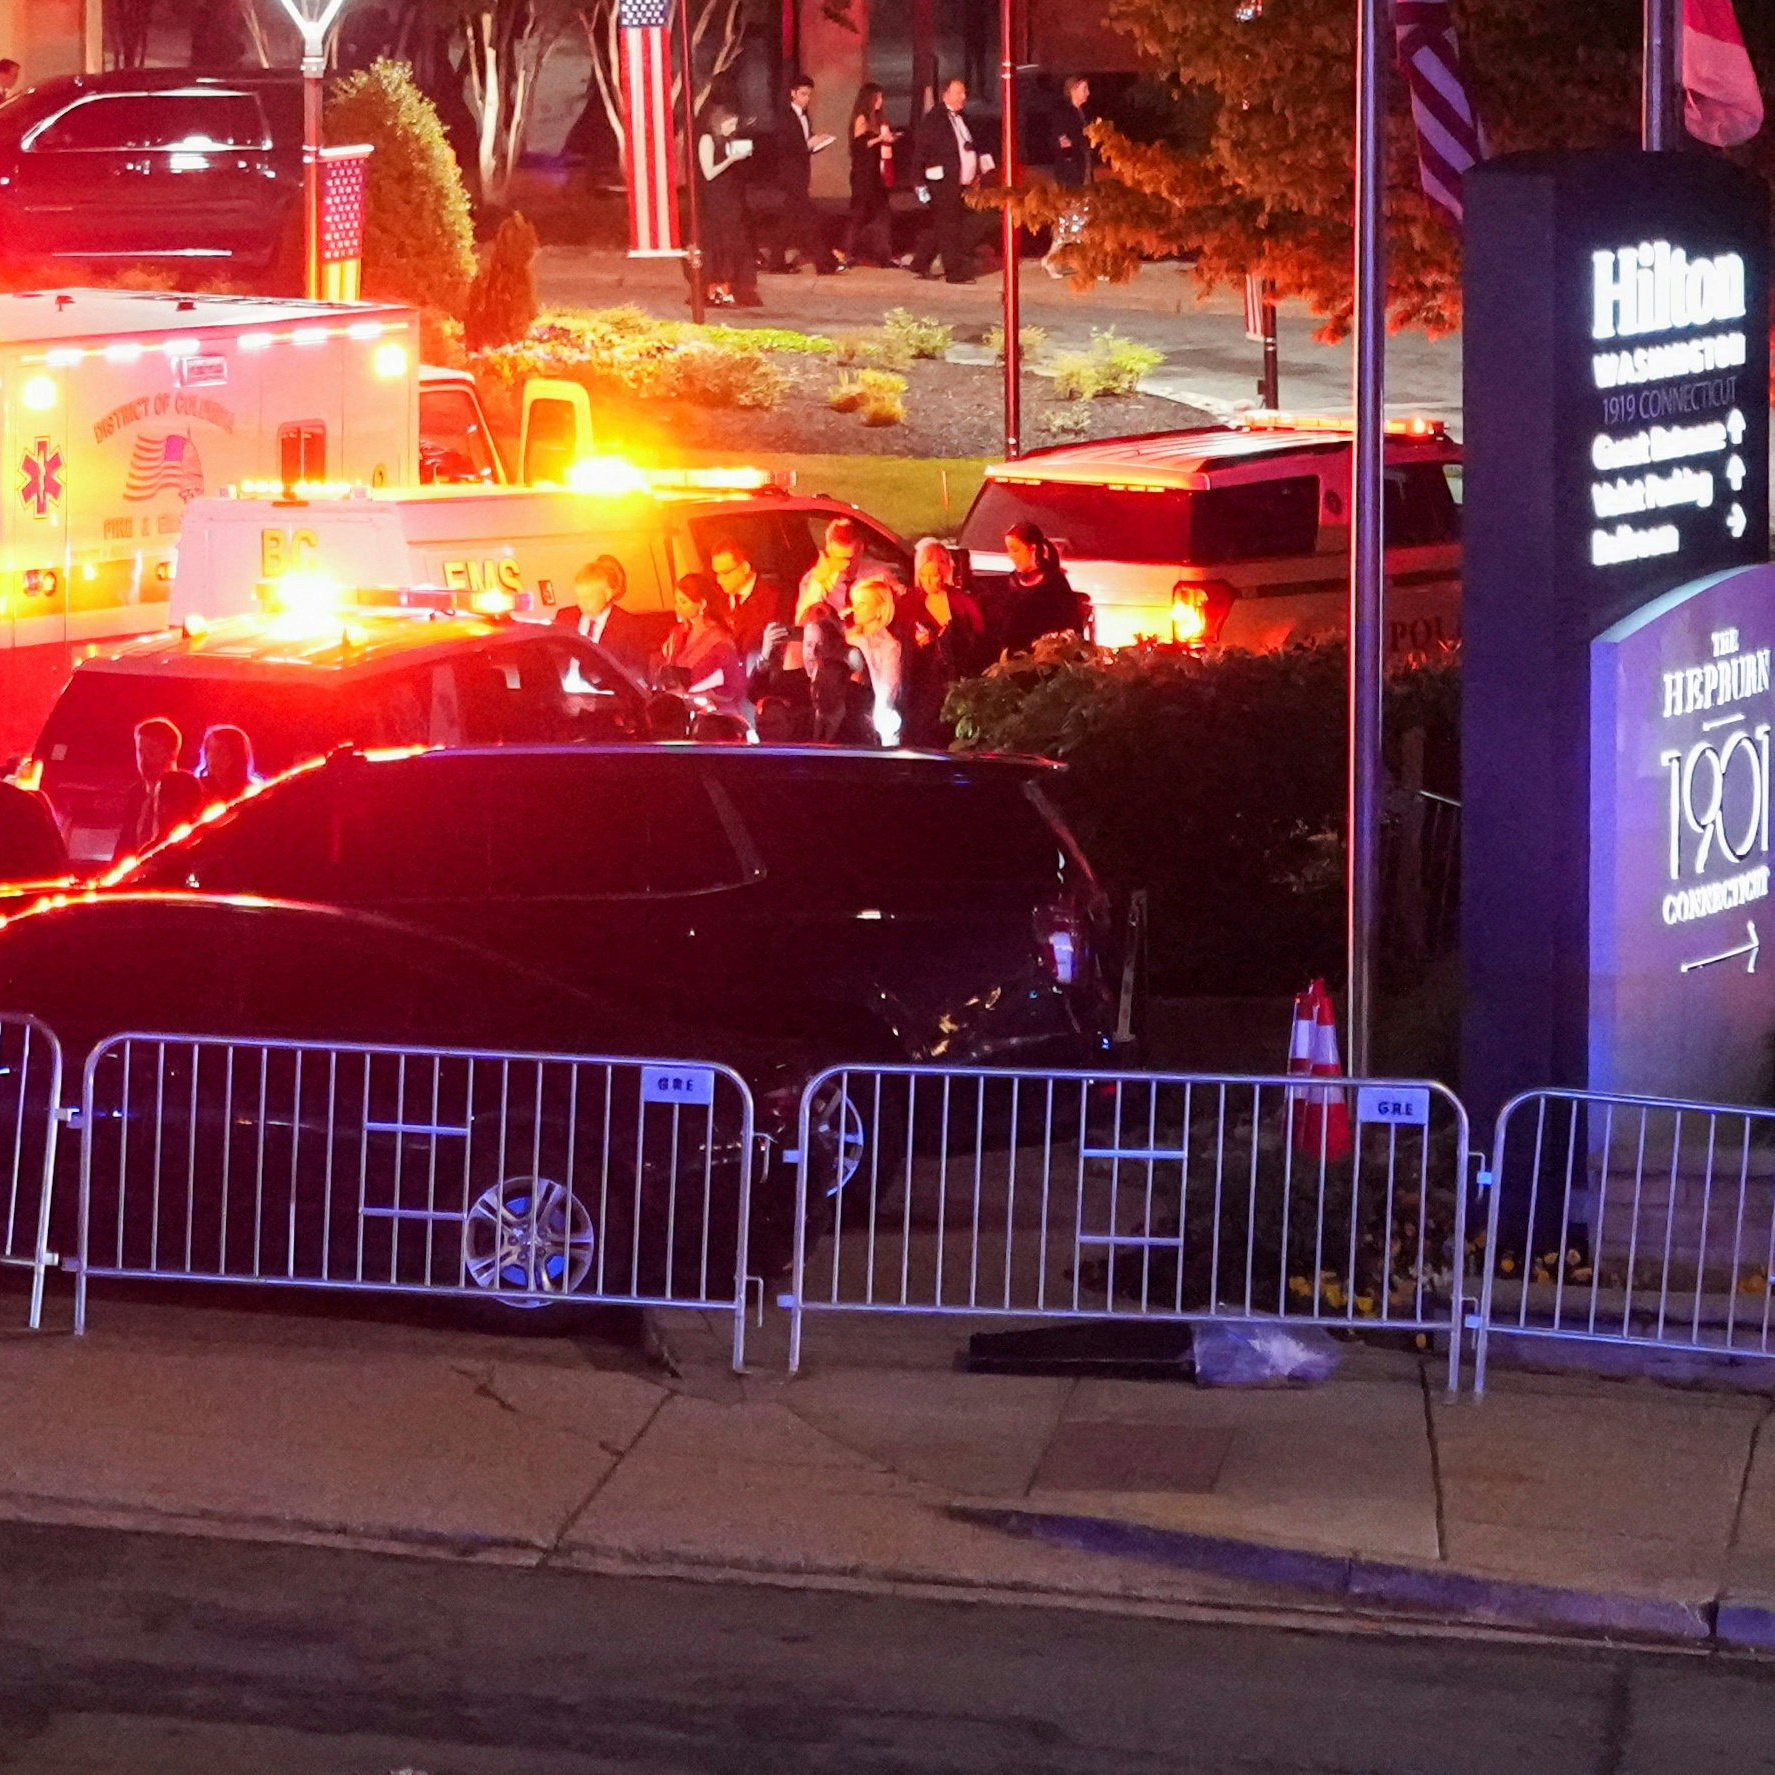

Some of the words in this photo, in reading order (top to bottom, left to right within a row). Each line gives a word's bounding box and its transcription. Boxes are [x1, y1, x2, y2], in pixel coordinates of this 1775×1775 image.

[1592, 240, 1746, 340] Hilton
[1593, 332, 1746, 389] WASHINGTON
[154, 392, 170, 416] OF
[1603, 394, 1636, 425] 1919
[1639, 376, 1737, 420] CONNECTICUT
[1711, 627, 1740, 657] THE
[1663, 648, 1771, 718] HEPBURN
[1660, 724, 1772, 880] 1901
[1662, 865, 1771, 925] CONNECTICUT
